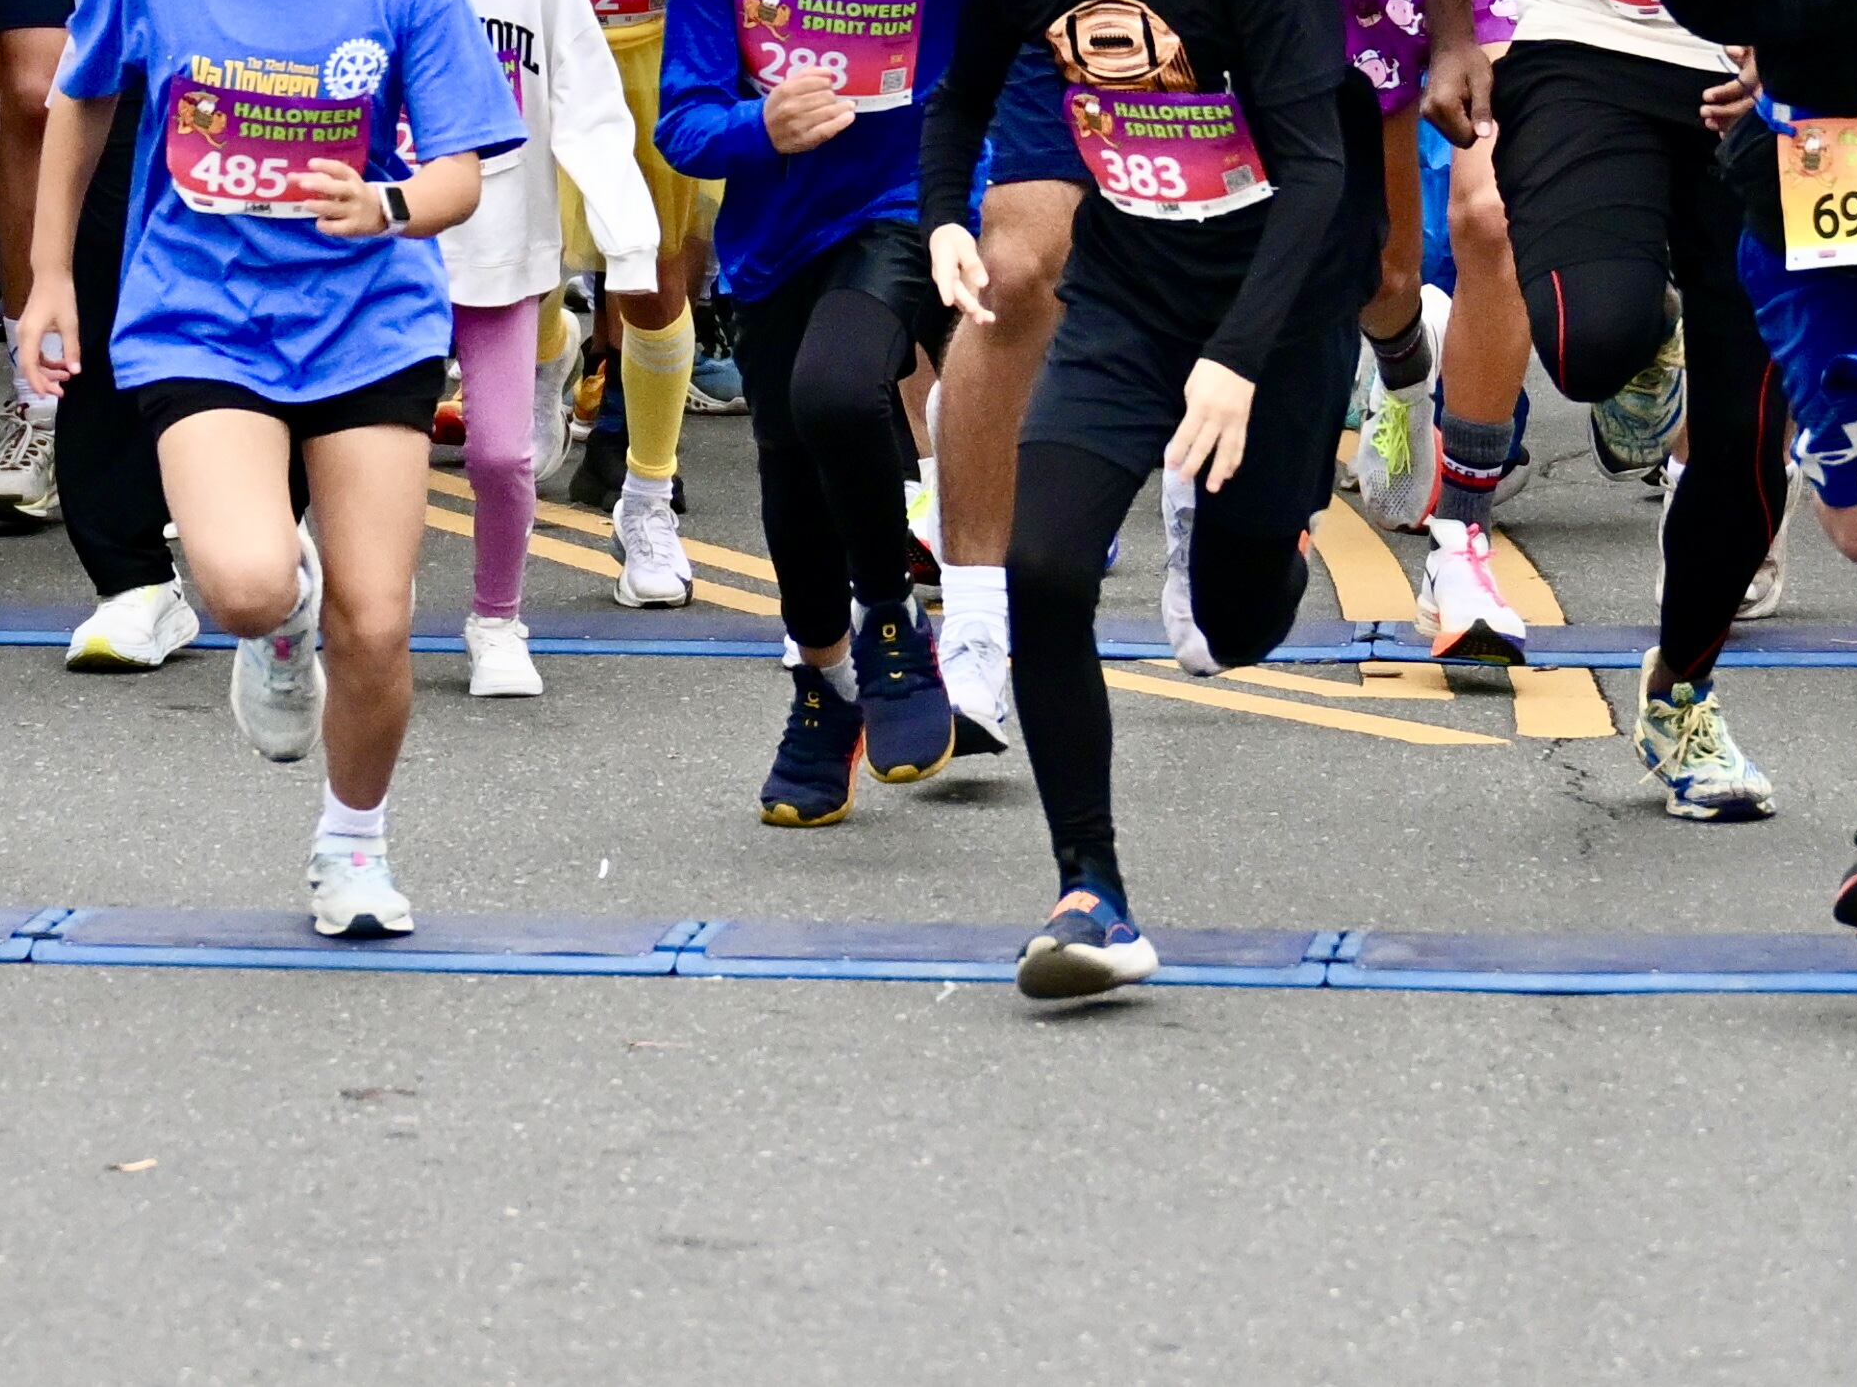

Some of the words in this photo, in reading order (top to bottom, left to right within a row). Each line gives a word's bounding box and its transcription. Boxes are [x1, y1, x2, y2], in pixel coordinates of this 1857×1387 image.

[802, 15, 866, 35] SPIRIT
[869, 19, 913, 36] RUN
[192, 54, 320, 99] Halloween
[758, 42, 848, 91] 288
[234, 101, 362, 126] HALLOWEEN
[1113, 101, 1233, 121] HALLOWEEN
[239, 121, 308, 142] SPIRIT
[312, 124, 359, 142] RUN
[1124, 121, 1184, 139] SPIRIT
[1189, 122, 1236, 139] RUN
[190, 150, 289, 199] 485
[1100, 149, 1188, 199] 383
